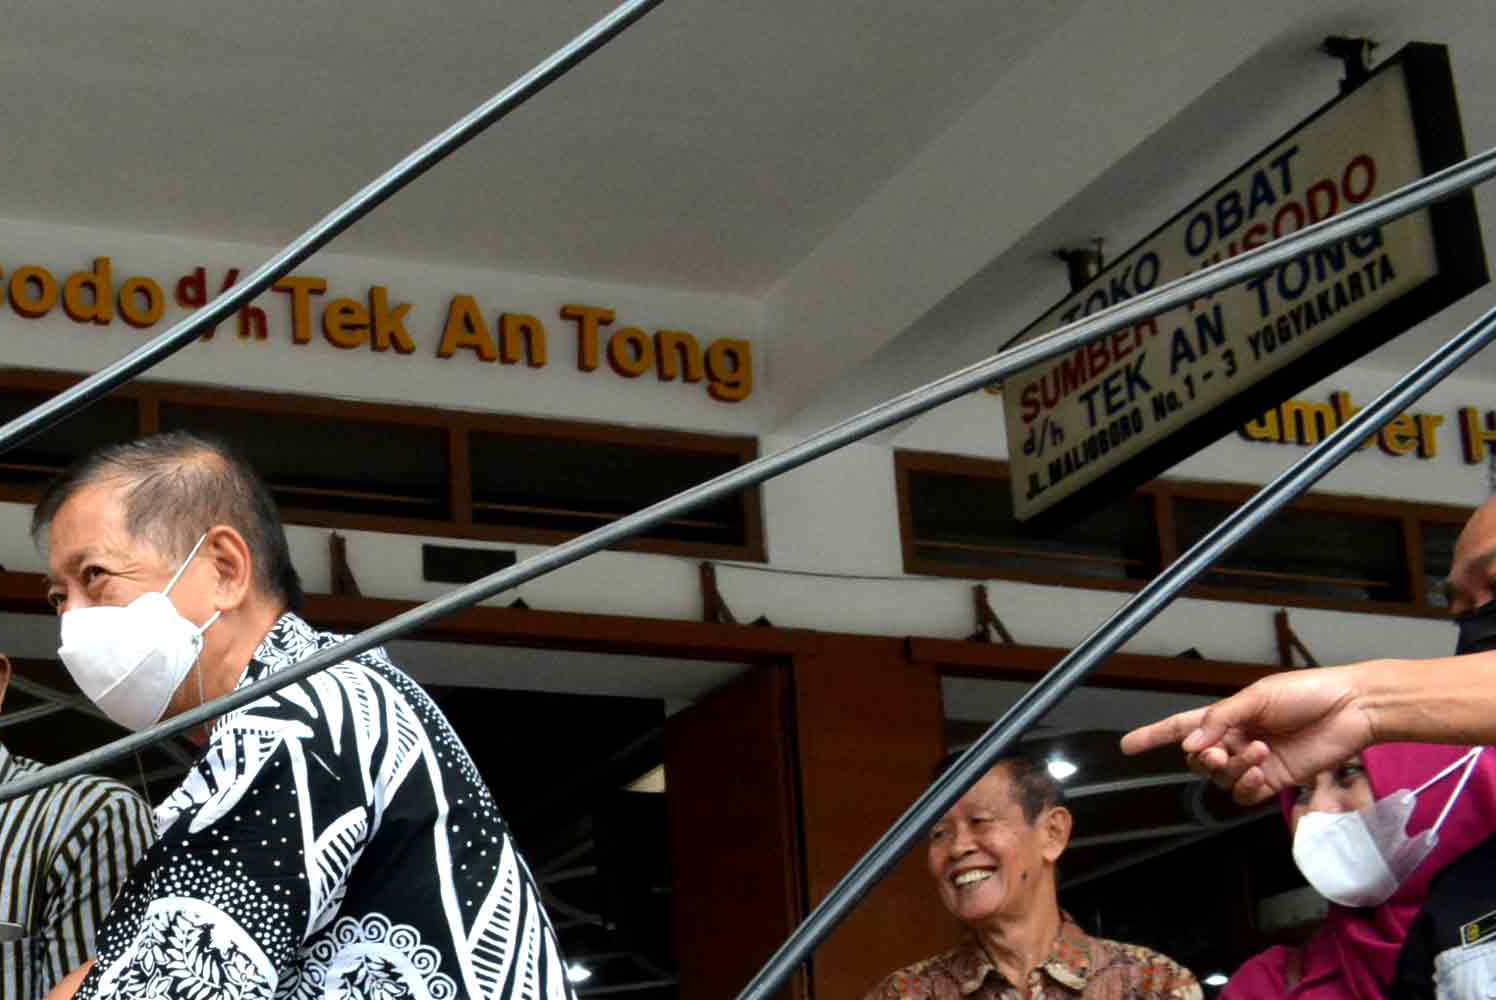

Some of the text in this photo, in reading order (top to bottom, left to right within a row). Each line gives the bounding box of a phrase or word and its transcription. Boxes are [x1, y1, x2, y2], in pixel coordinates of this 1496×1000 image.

[1184, 146, 1301, 257] OBAT
[270, 274, 416, 354] Tek
[438, 294, 550, 369] An
[559, 303, 756, 403] Tong
[1023, 414, 1065, 457] d/h
[1078, 351, 1153, 428] TEK
[1168, 303, 1226, 376] AN
[1183, 372, 1196, 401] 1
[1221, 347, 1238, 378] 3
[1247, 253, 1397, 361] YOGYAKARTA
